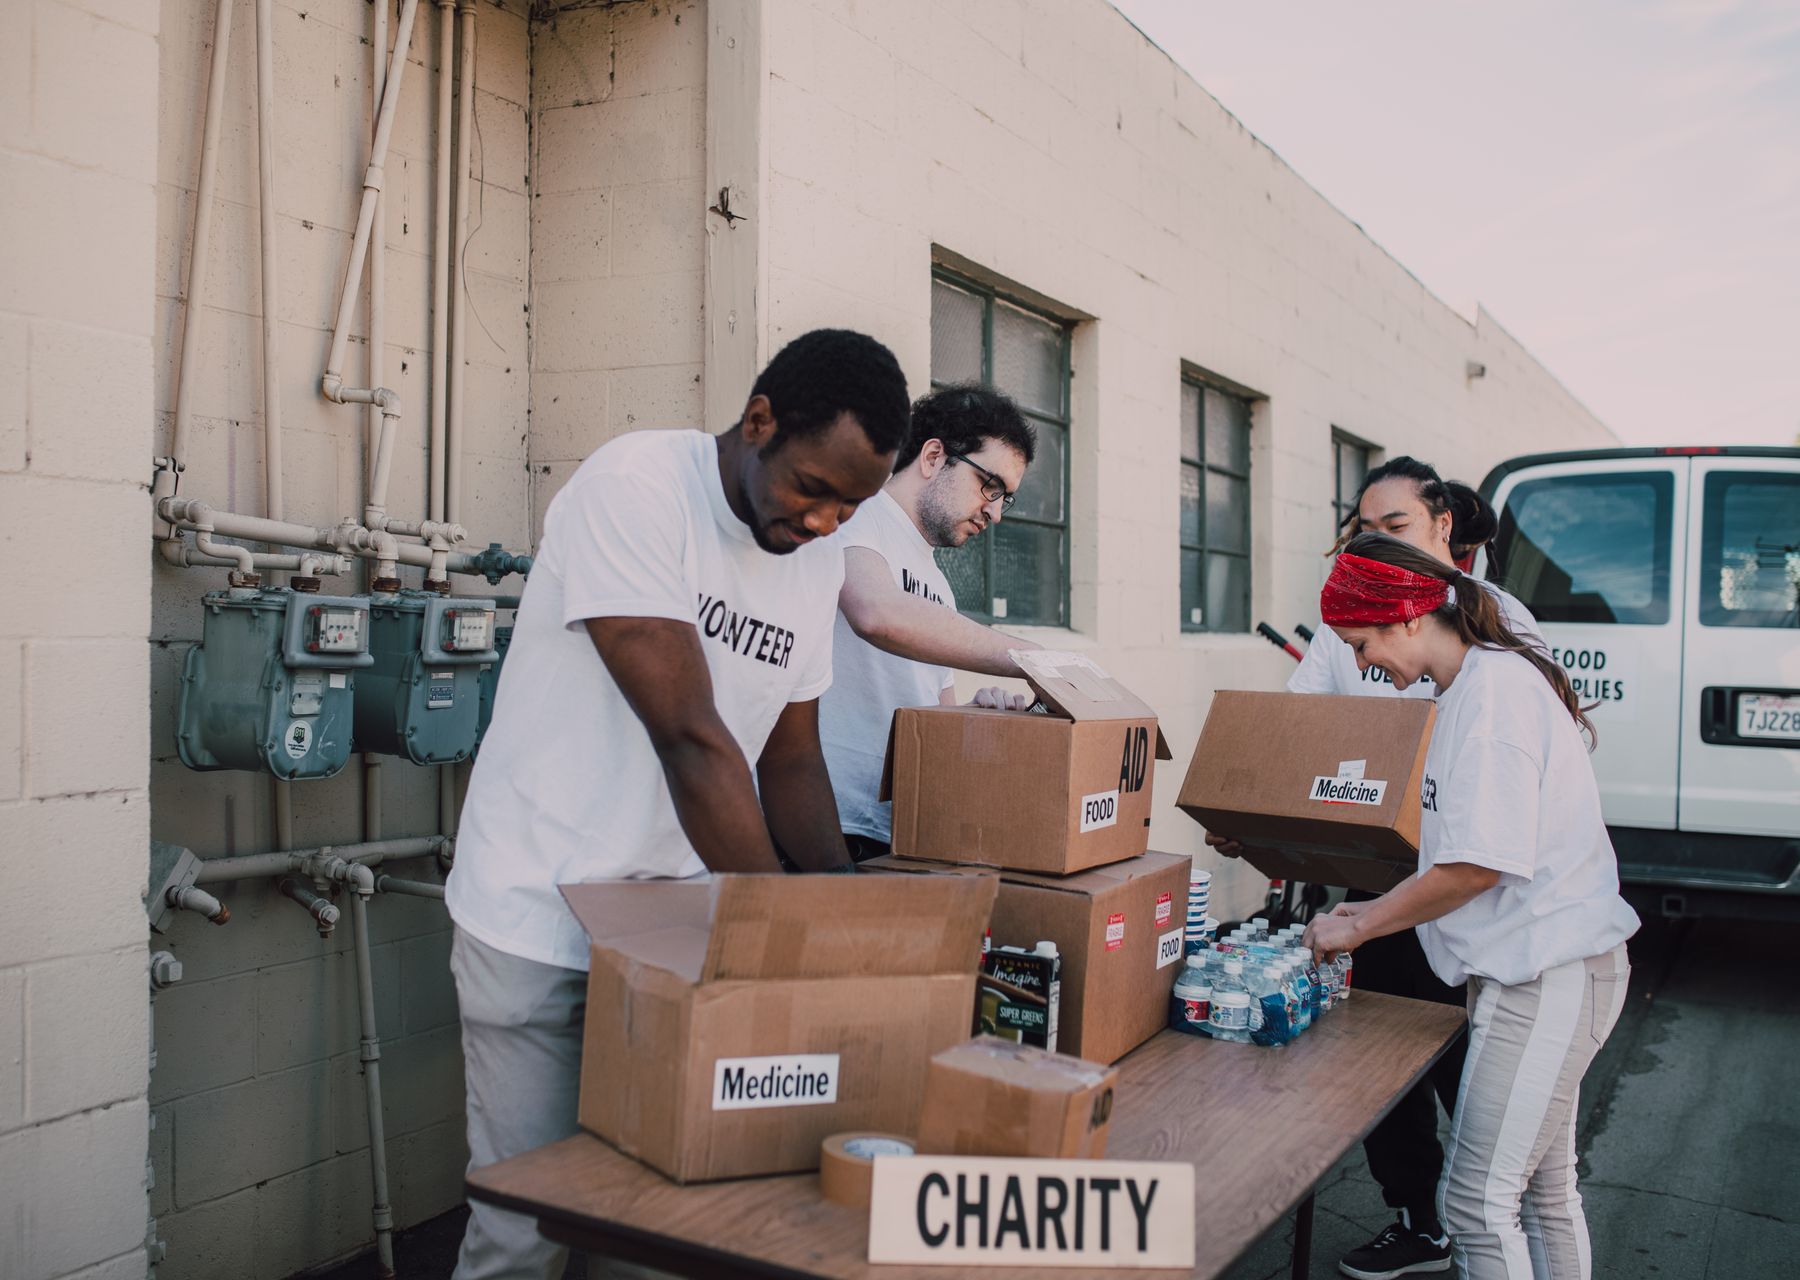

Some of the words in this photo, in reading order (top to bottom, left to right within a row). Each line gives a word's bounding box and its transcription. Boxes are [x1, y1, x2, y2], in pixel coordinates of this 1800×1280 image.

[1552, 648, 1606, 670] FOOD
[1119, 726, 1148, 794] AID
[1315, 779, 1379, 802] Medicine
[1085, 796, 1114, 825] FOOD
[1161, 937, 1180, 960] FOOD
[999, 1006, 1020, 1020] SUPER
[1021, 1009, 1044, 1024] GREENS
[721, 1064, 830, 1101] Medicine
[916, 1172, 1159, 1252] CHARITY
